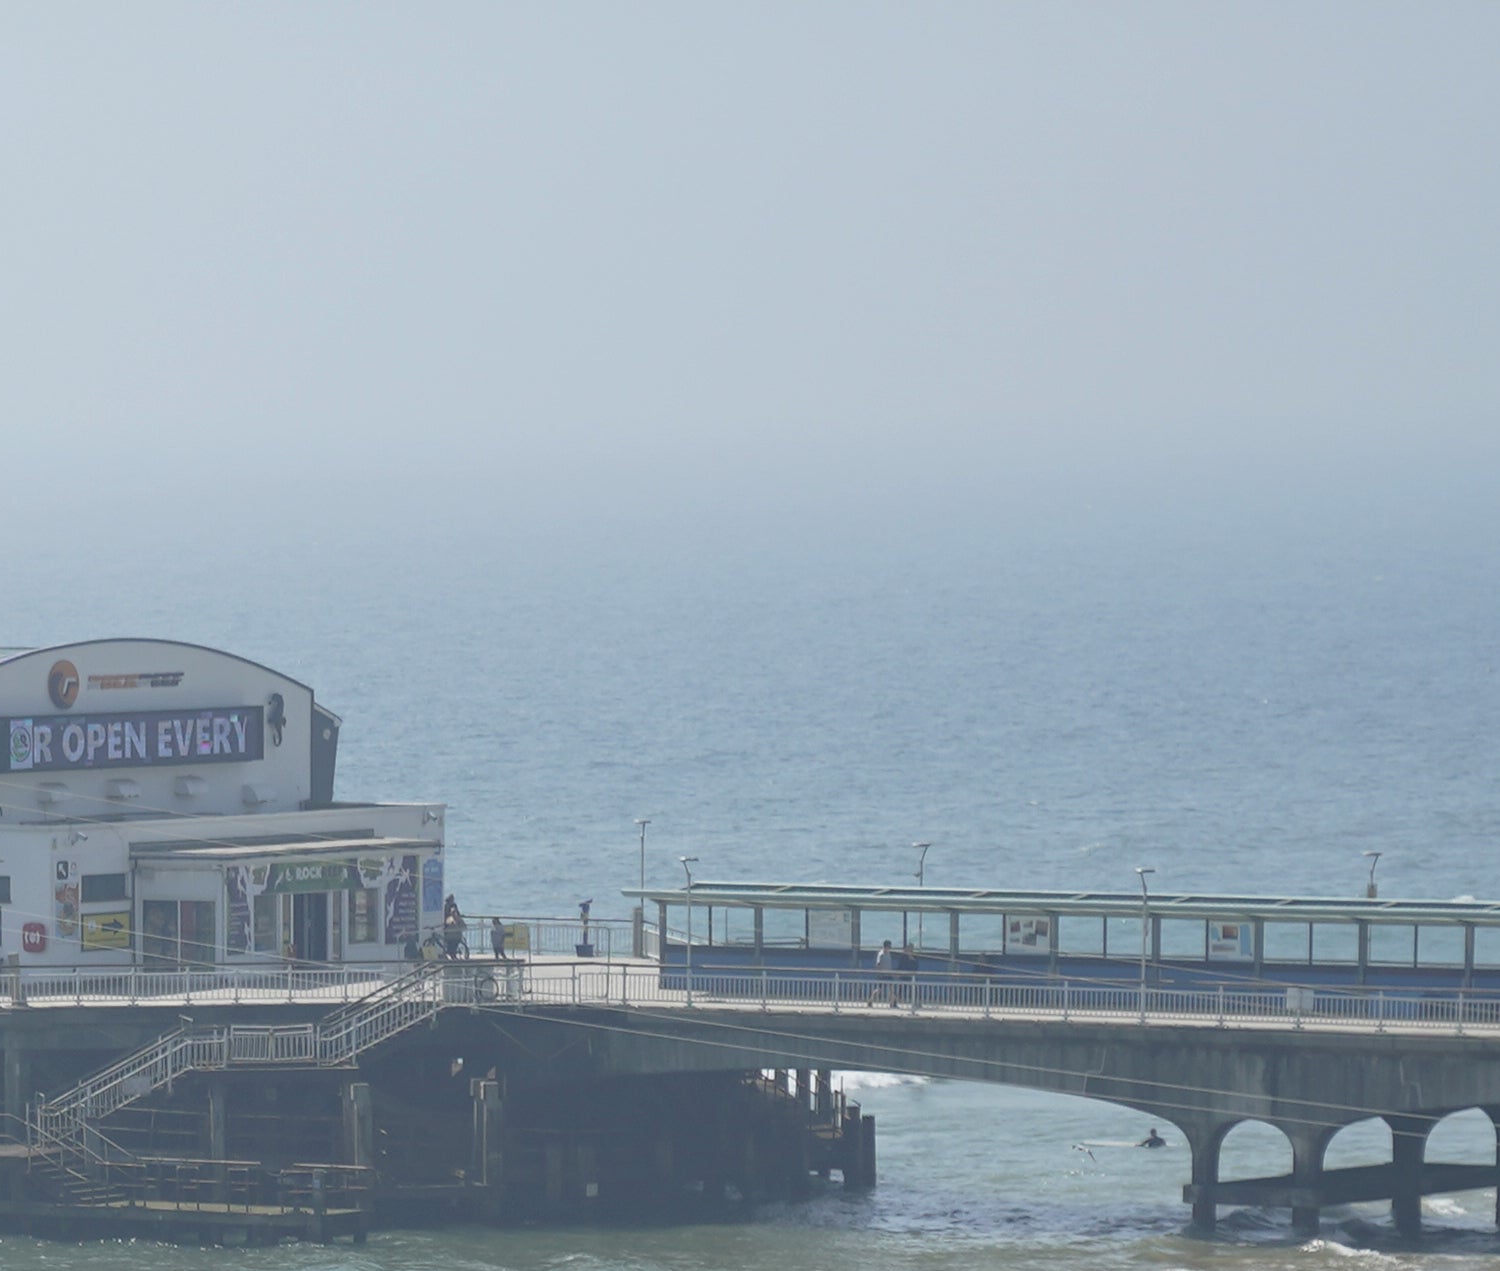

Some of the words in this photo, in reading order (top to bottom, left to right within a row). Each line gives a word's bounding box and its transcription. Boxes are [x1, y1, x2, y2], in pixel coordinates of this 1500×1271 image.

[62, 721, 147, 762] OPEN
[158, 716, 247, 758] EVERY
[296, 867, 322, 881] ROCK
